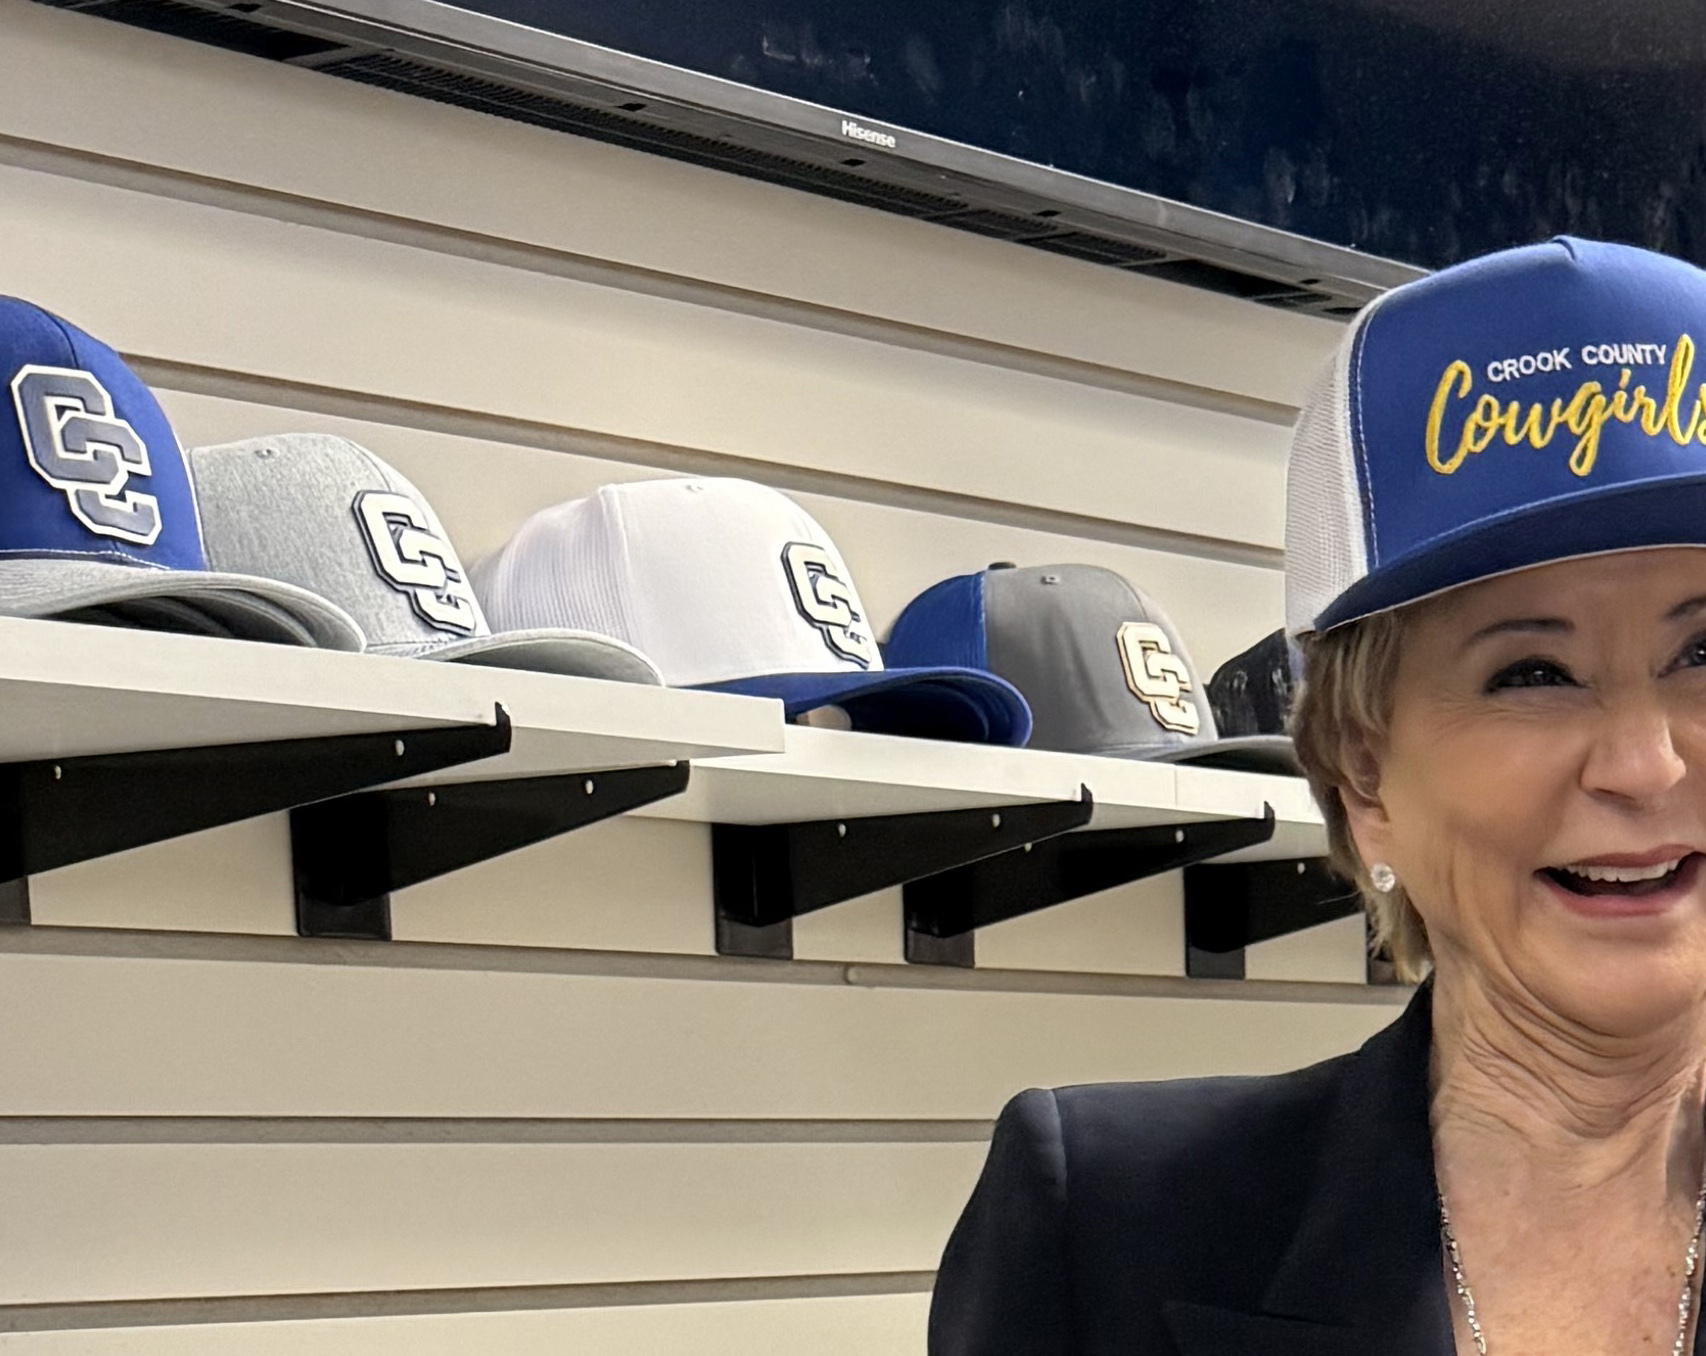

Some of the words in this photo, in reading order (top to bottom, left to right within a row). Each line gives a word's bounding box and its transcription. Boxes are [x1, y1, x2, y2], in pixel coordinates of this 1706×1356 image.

[841, 119, 897, 149] Hisense
[1486, 347, 1573, 383] CROOK
[1581, 343, 1667, 366] COUNTY
